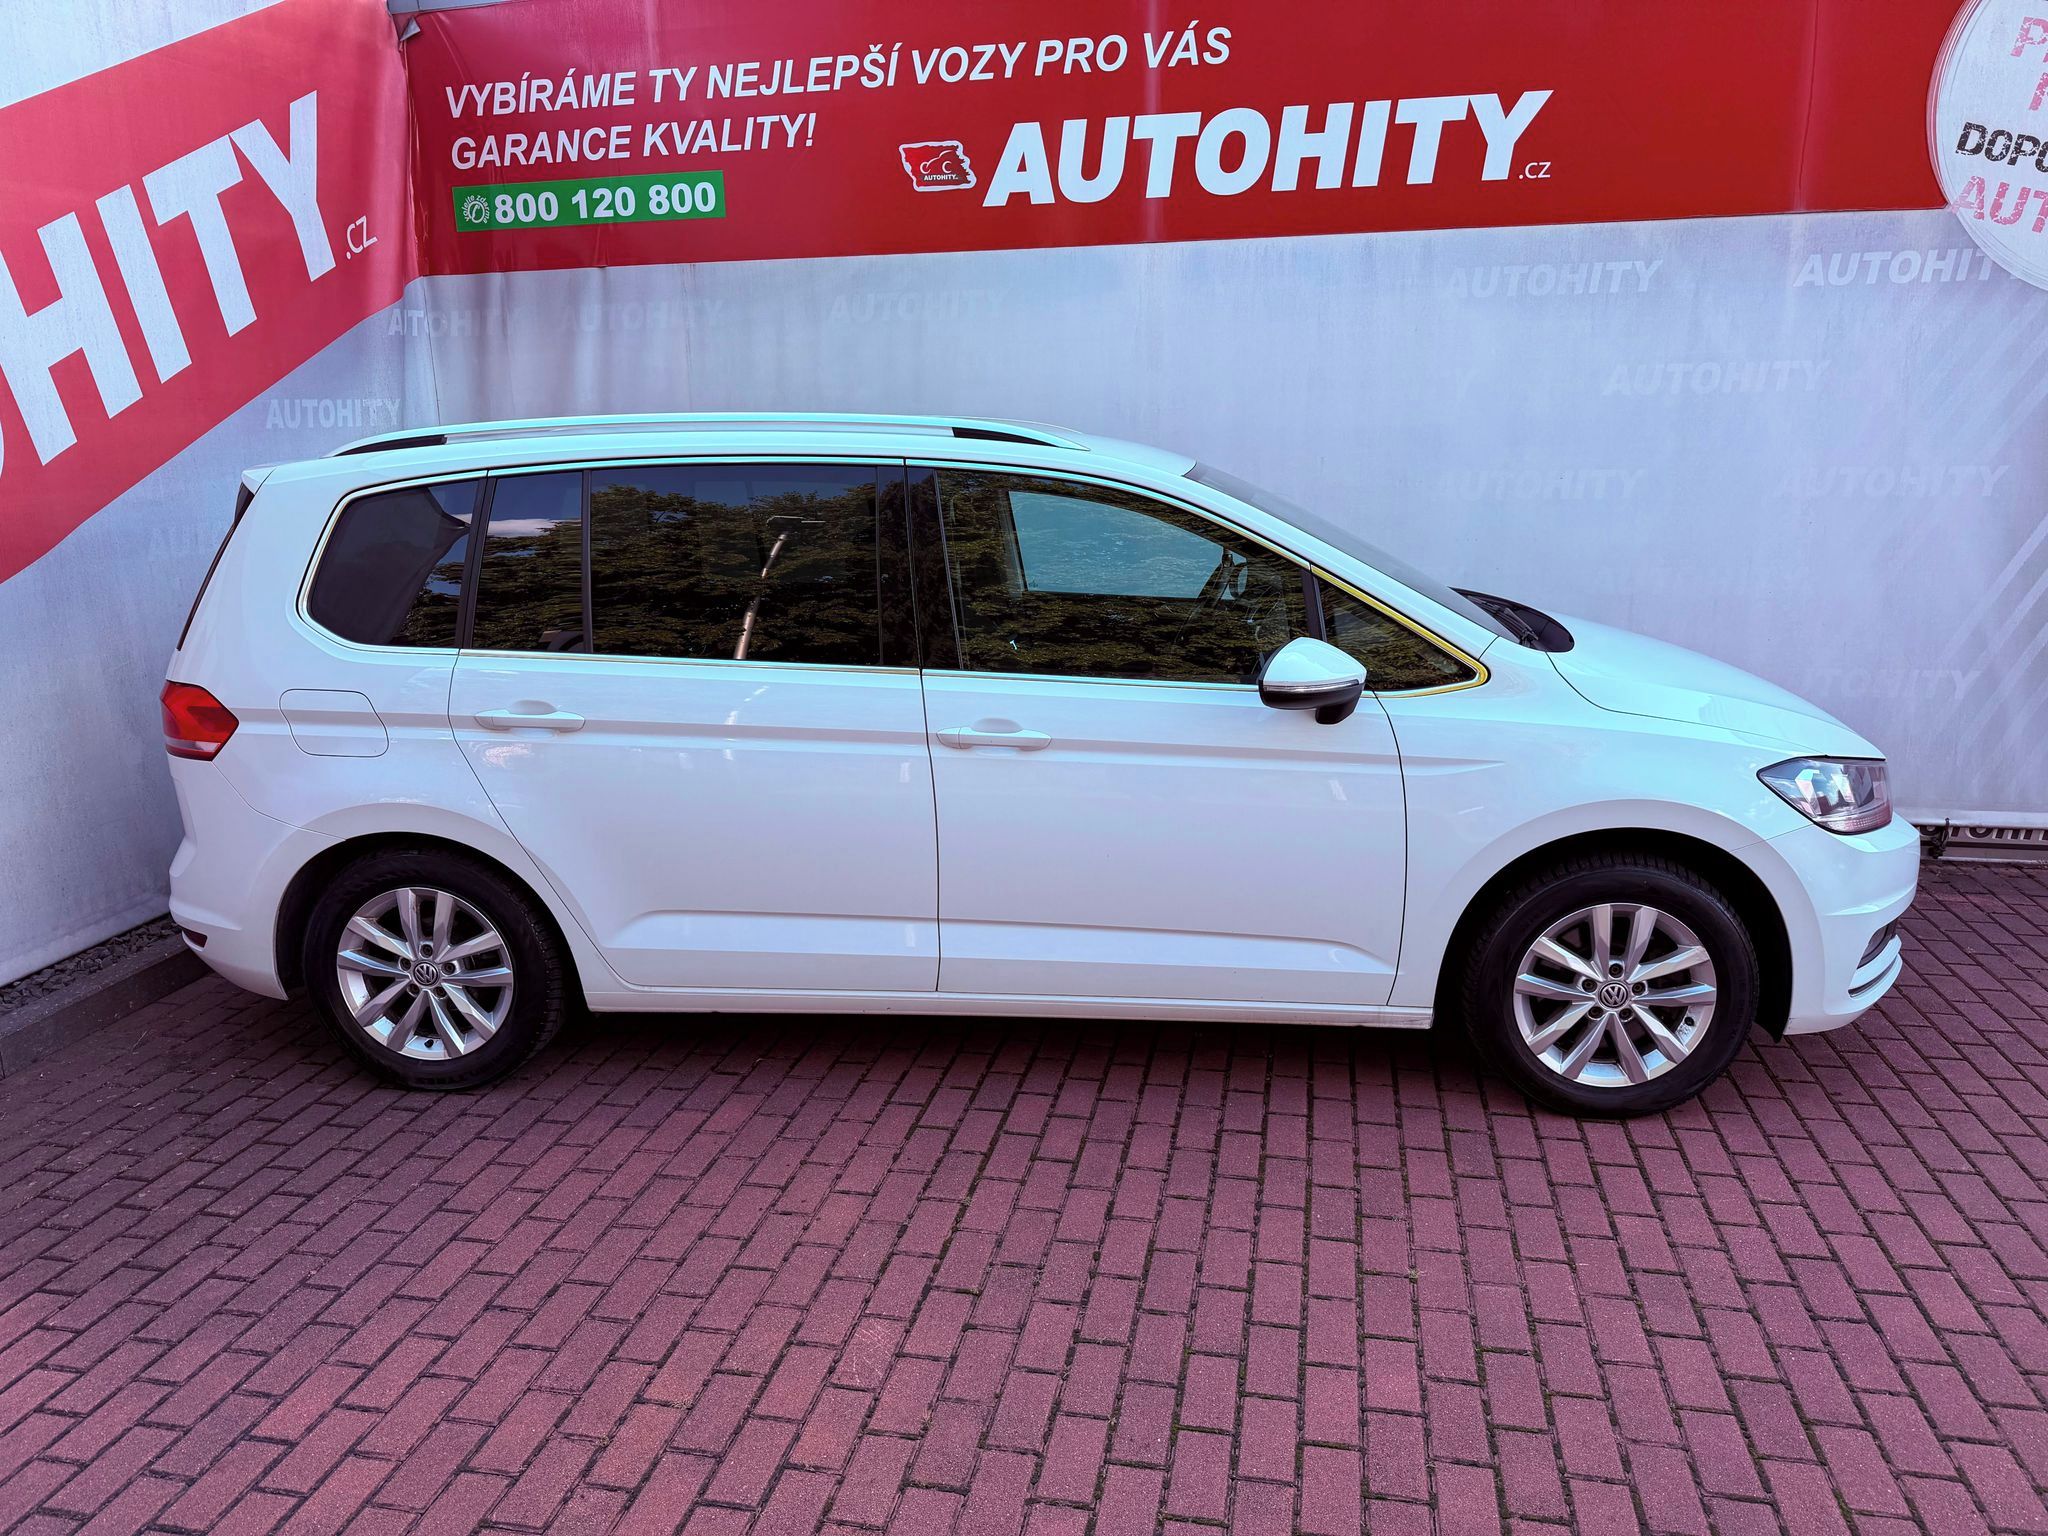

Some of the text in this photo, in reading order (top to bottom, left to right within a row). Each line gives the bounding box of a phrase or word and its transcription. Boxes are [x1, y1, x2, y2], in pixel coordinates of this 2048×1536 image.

[446, 20, 1232, 118] VYBÍRÁME TY NEJLEPŠÍ VOZY PRO VÁS
[451, 112, 817, 170] GARANCE KVALITY!
[494, 181, 717, 224] 800 120 800
[1445, 260, 1663, 298] AUTOHITY
[1793, 249, 2018, 286] AUTOHIT
[265, 398, 401, 430] AUTOHITY
